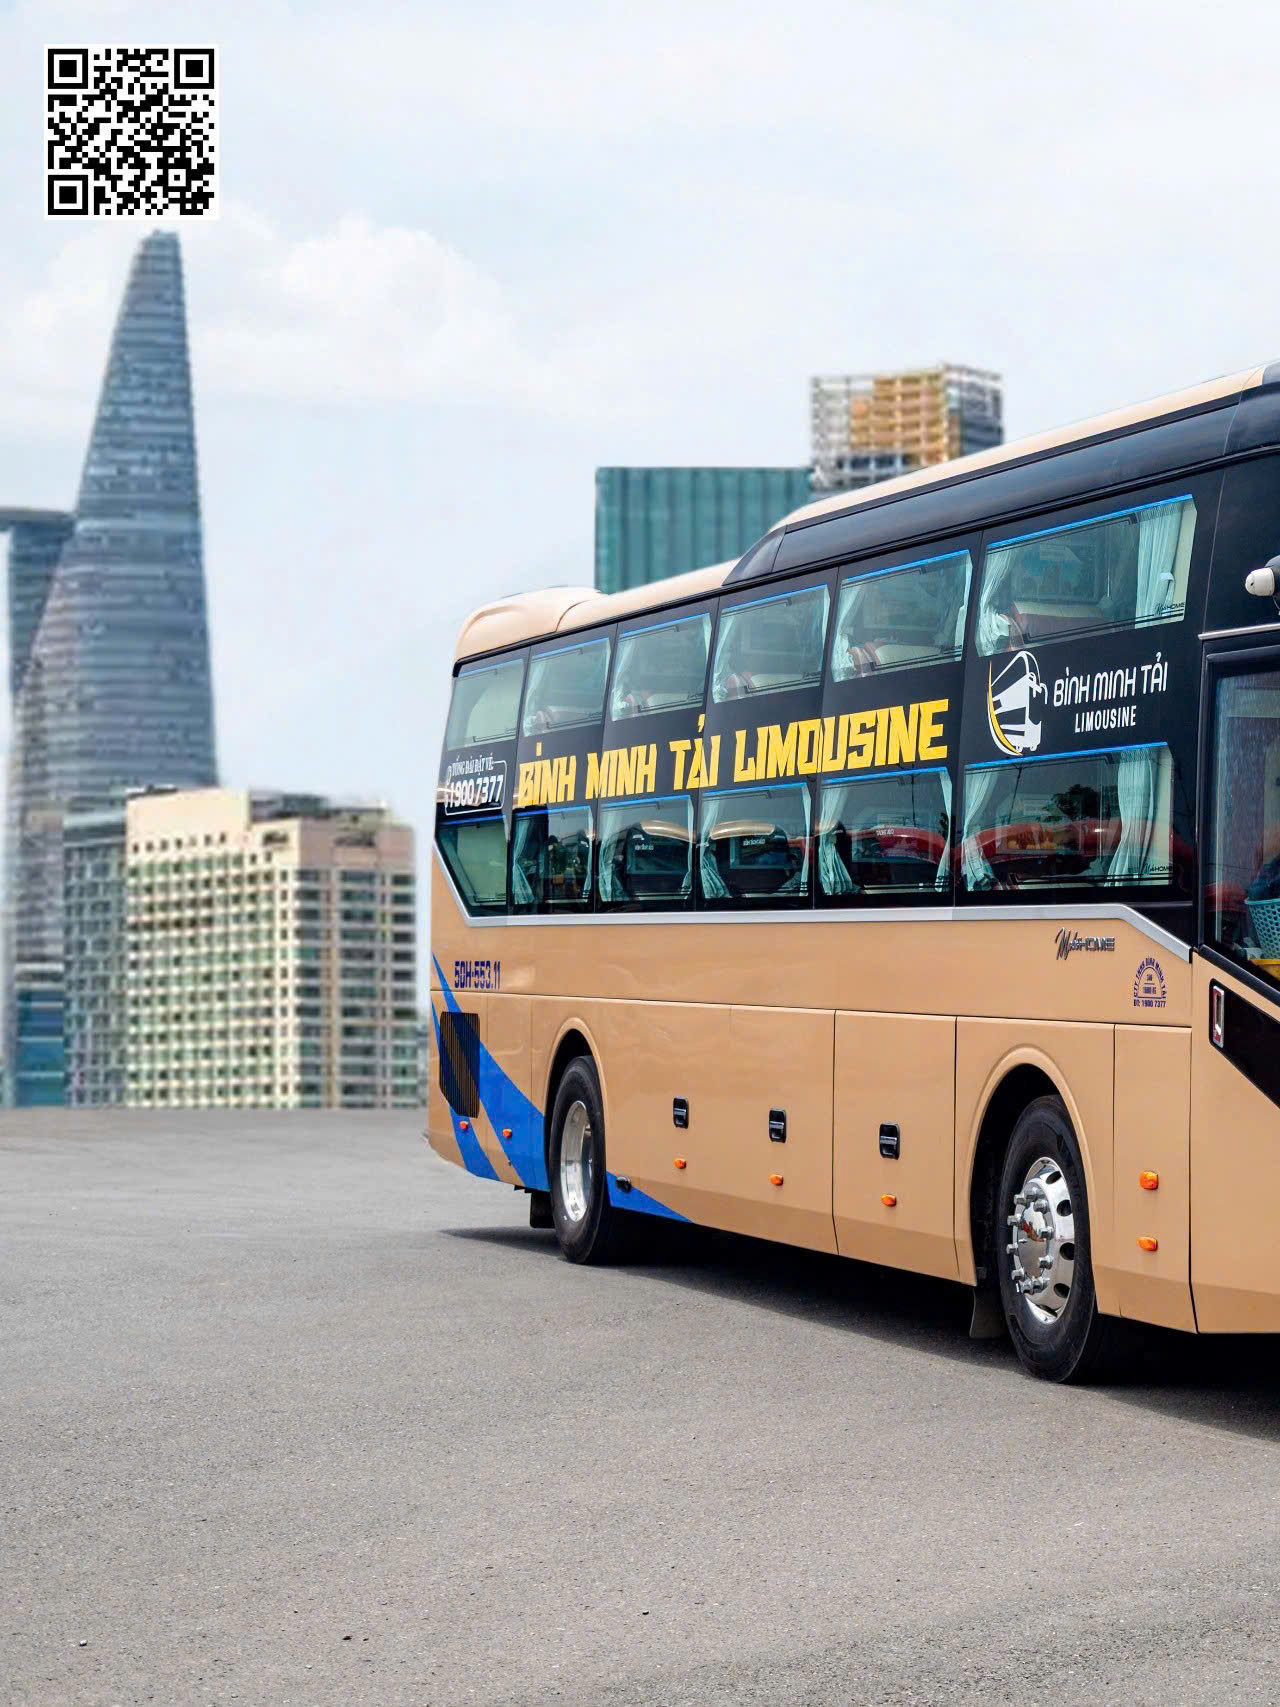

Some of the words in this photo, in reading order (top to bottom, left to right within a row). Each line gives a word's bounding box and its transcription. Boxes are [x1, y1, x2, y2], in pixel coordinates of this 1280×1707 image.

[1053, 666, 1090, 707] BÌNH
[1092, 667, 1137, 702] MINH
[1140, 651, 1169, 695] TẢI
[1074, 705, 1137, 734] LIMOUSINE
[585, 743, 657, 800] MINH
[669, 713, 721, 791] TẢI
[732, 698, 950, 783] LIMOUSINE
[454, 960, 501, 990] 50H-553.11
